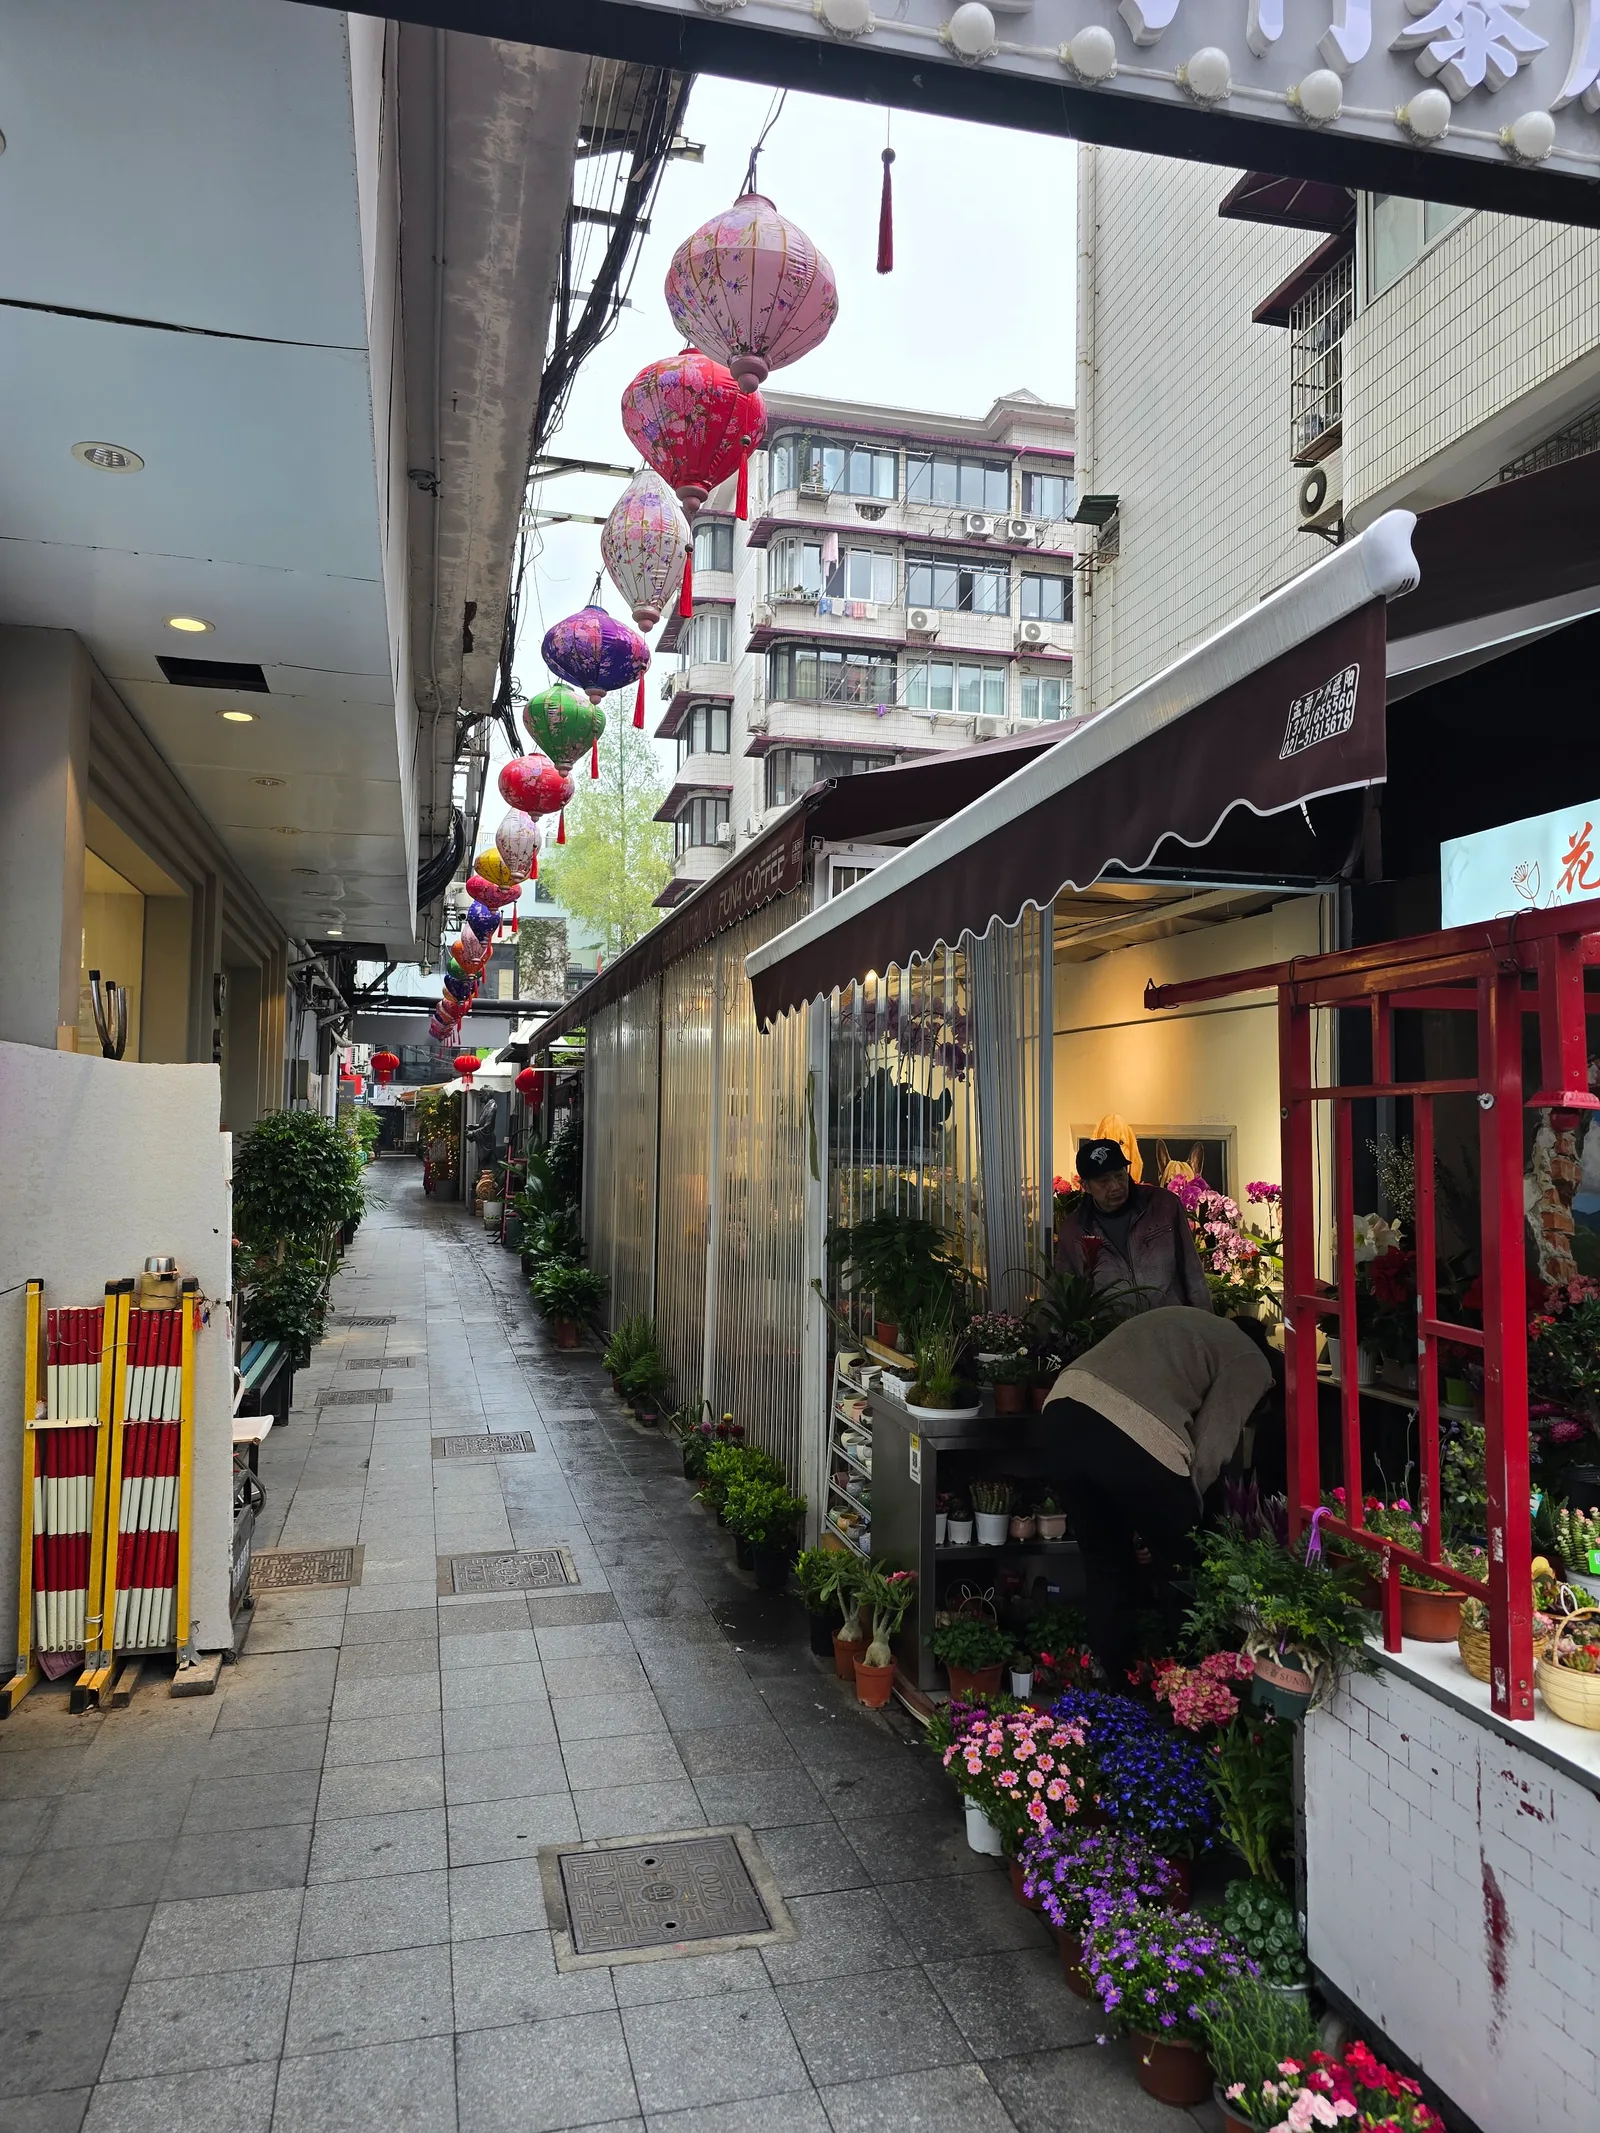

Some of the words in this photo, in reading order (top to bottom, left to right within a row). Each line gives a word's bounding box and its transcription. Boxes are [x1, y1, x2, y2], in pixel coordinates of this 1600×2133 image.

[1281, 709, 1351, 756] 021-51315678
[1287, 689, 1354, 739] 13701655560
[744, 844, 785, 901] COFFEE
[1557, 821, 1600, 894] 花
[698, 1871, 727, 1902] 2001
